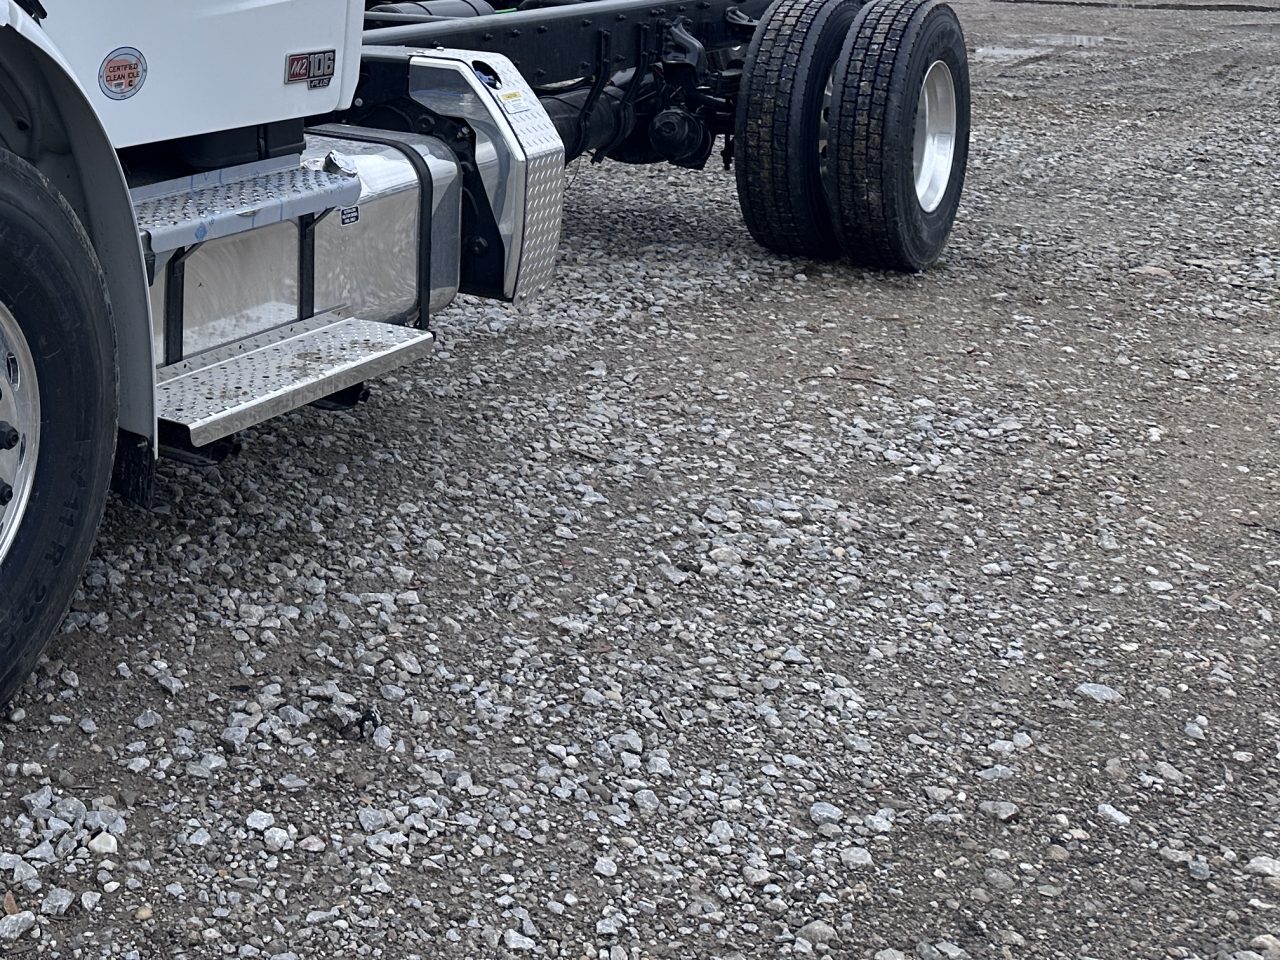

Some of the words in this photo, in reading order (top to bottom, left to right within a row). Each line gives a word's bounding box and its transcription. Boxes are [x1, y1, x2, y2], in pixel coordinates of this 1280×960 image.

[108, 63, 138, 73] CERTIFIED
[290, 58, 308, 75] M2
[310, 52, 334, 77] 106
[105, 73, 125, 82] CLEAN
[128, 71, 140, 79] IDLE
